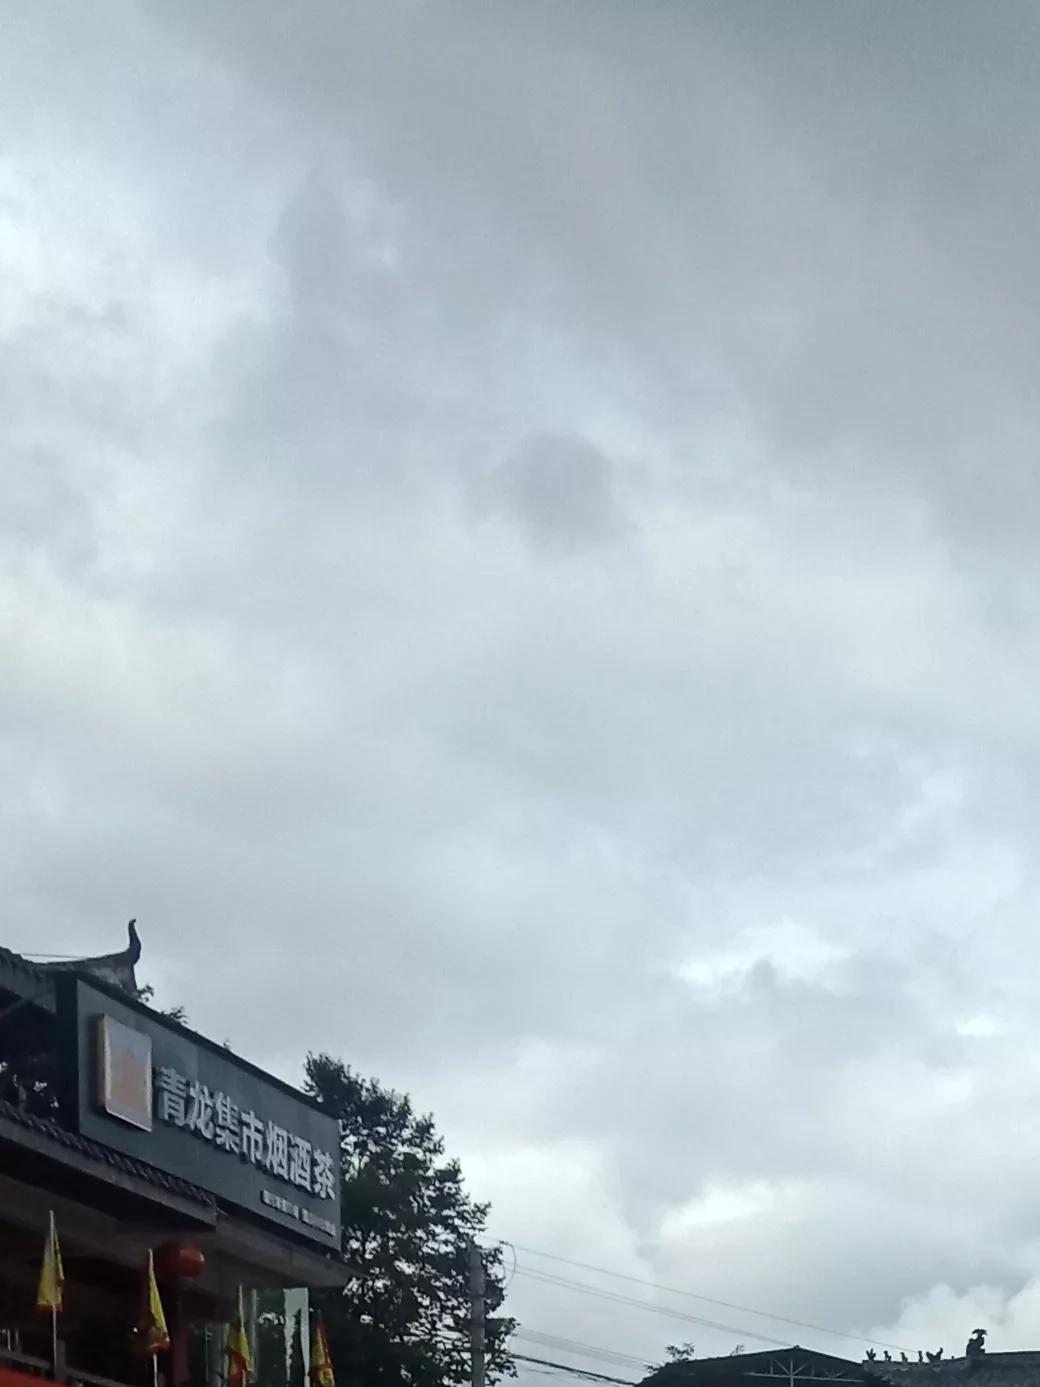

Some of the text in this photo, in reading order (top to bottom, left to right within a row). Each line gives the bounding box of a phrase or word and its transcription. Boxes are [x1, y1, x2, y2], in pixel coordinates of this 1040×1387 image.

[158, 1066, 336, 1201] 青龙集市烟酒茶
